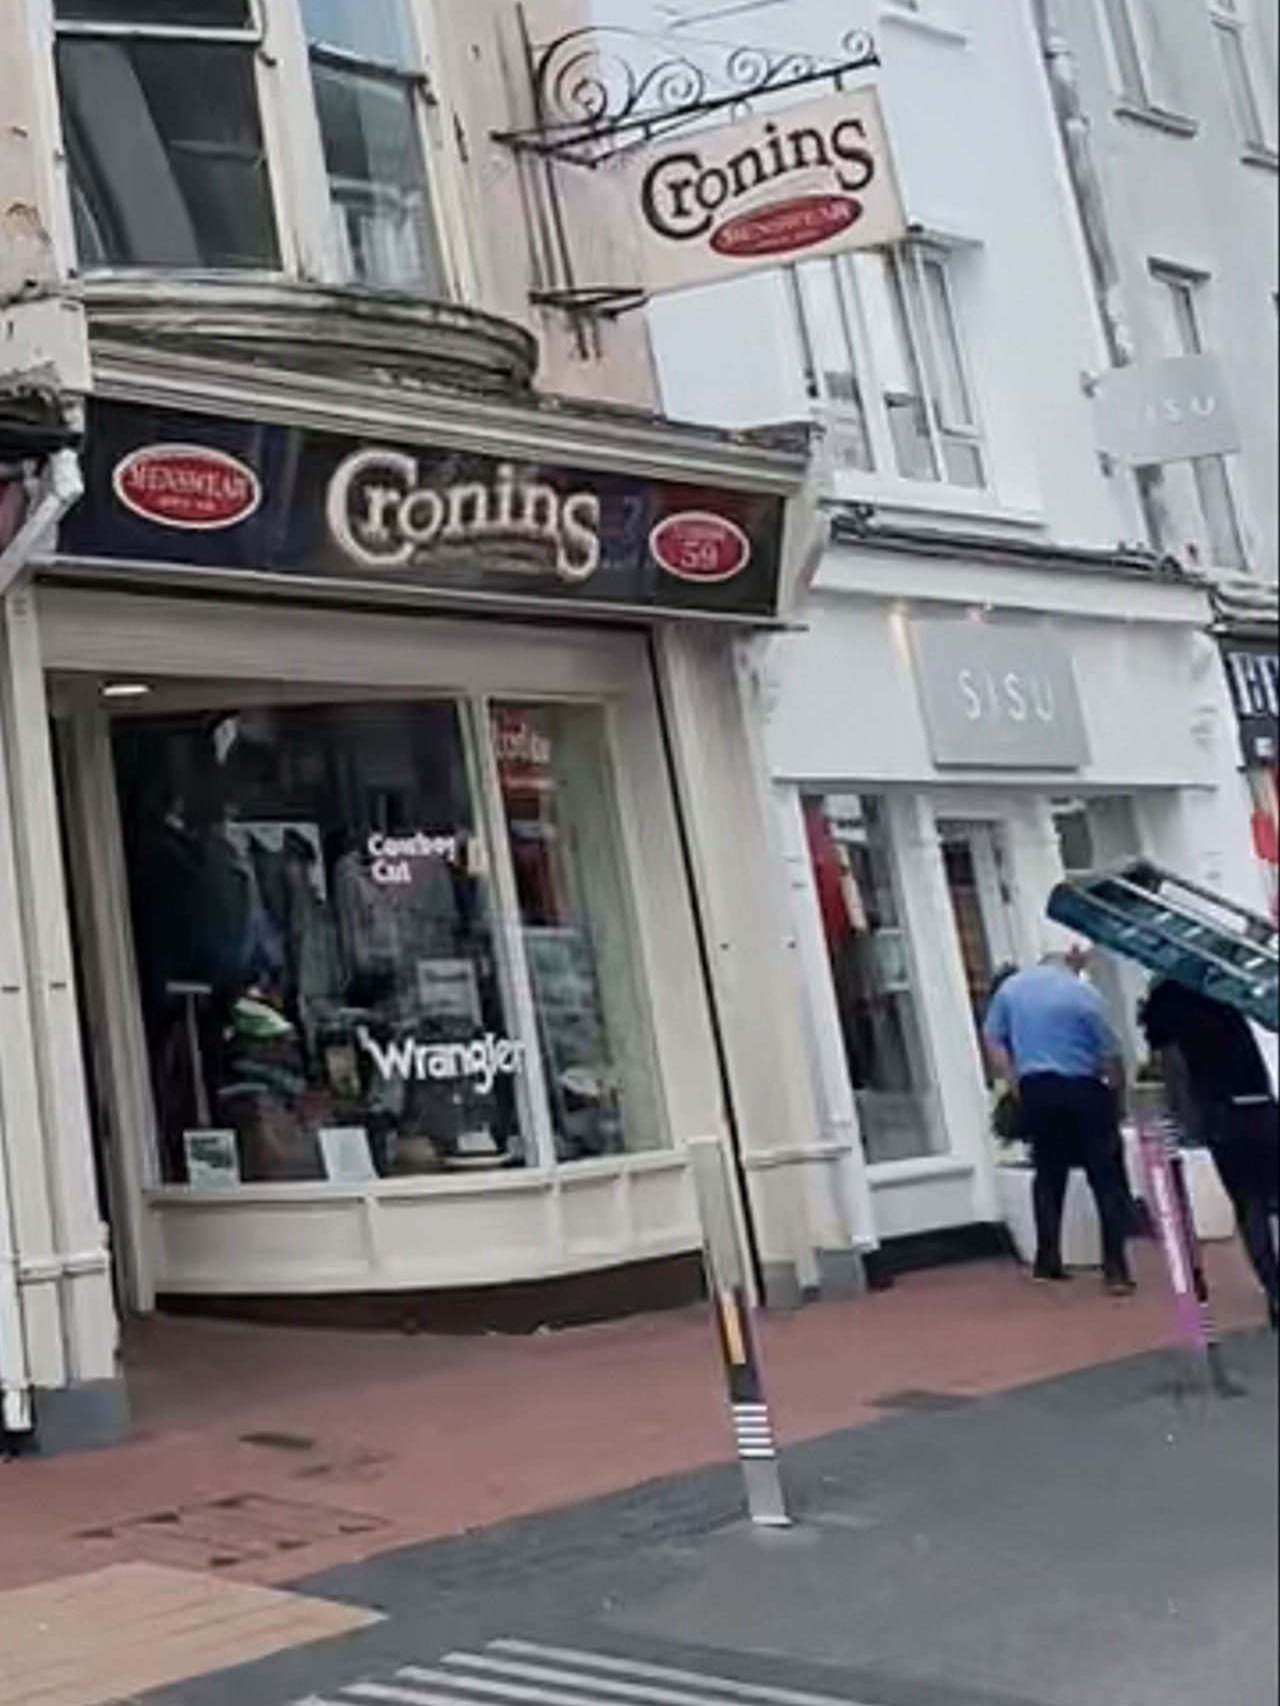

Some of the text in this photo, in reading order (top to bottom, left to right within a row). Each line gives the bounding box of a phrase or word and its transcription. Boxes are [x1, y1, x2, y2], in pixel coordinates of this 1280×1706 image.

[641, 118, 875, 241] Cronins
[327, 448, 601, 583] Cronins
[958, 669, 1053, 722] SISU
[371, 860, 411, 883] Cut
[357, 1025, 526, 1094] Wrangler
